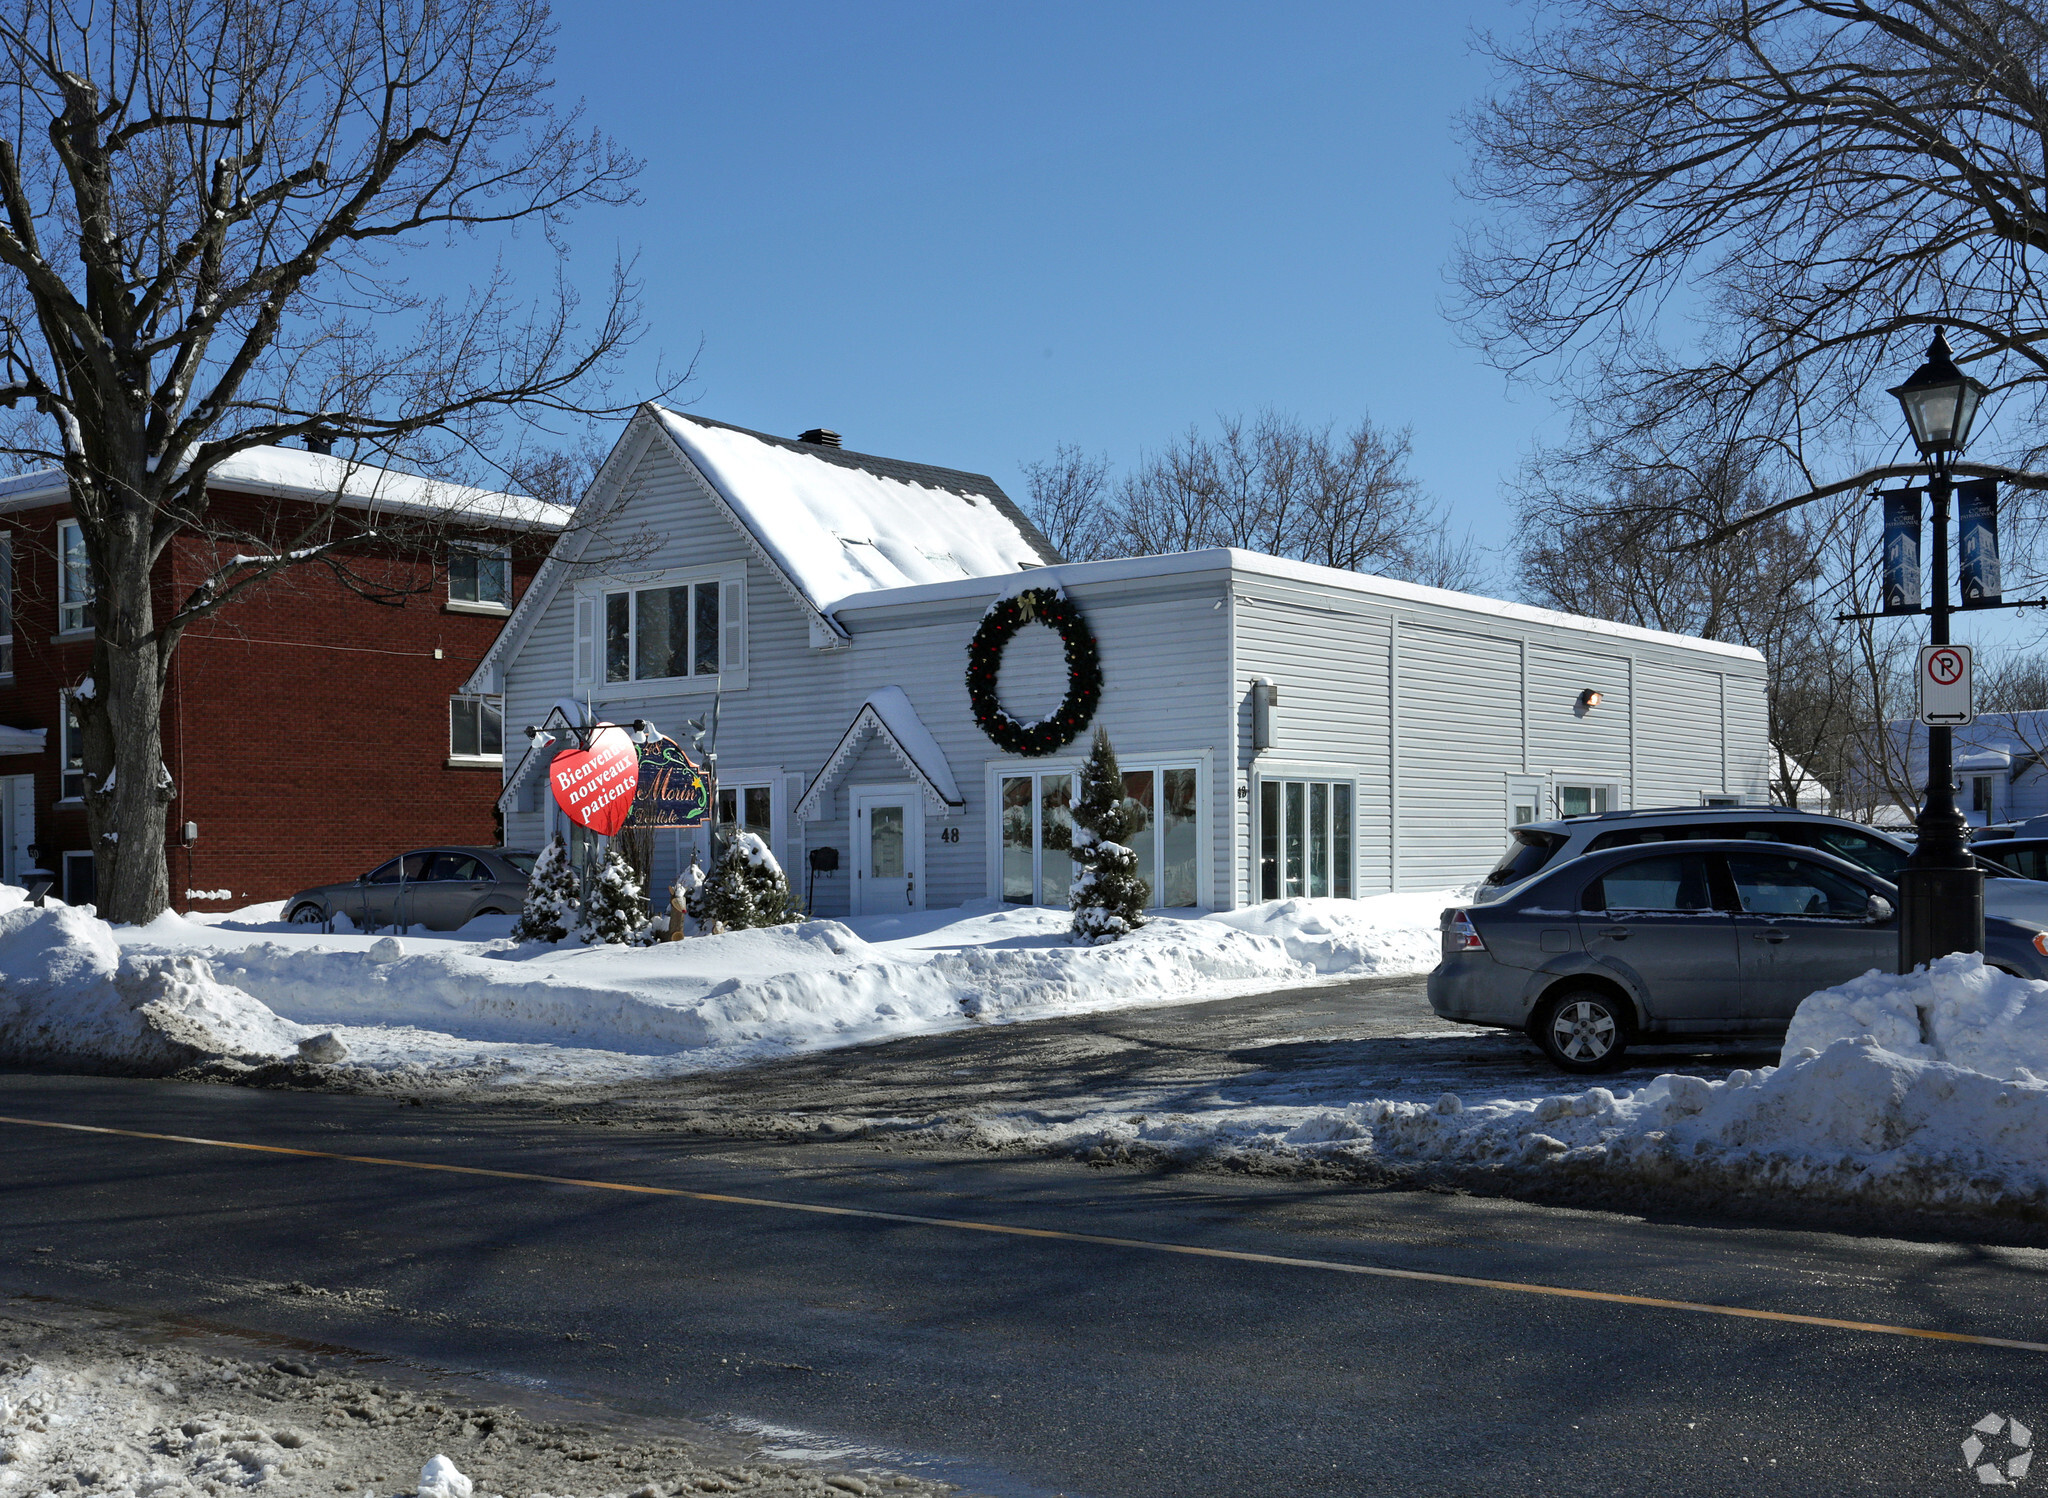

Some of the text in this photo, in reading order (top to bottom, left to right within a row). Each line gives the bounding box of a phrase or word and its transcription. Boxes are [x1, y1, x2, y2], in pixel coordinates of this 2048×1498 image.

[1941, 658, 1953, 676] P
[569, 755, 633, 805] nouveaux
[637, 767, 697, 801] Morin
[581, 775, 636, 825] patients
[941, 827, 959, 843] 48
[30, 849, 39, 860] 50
